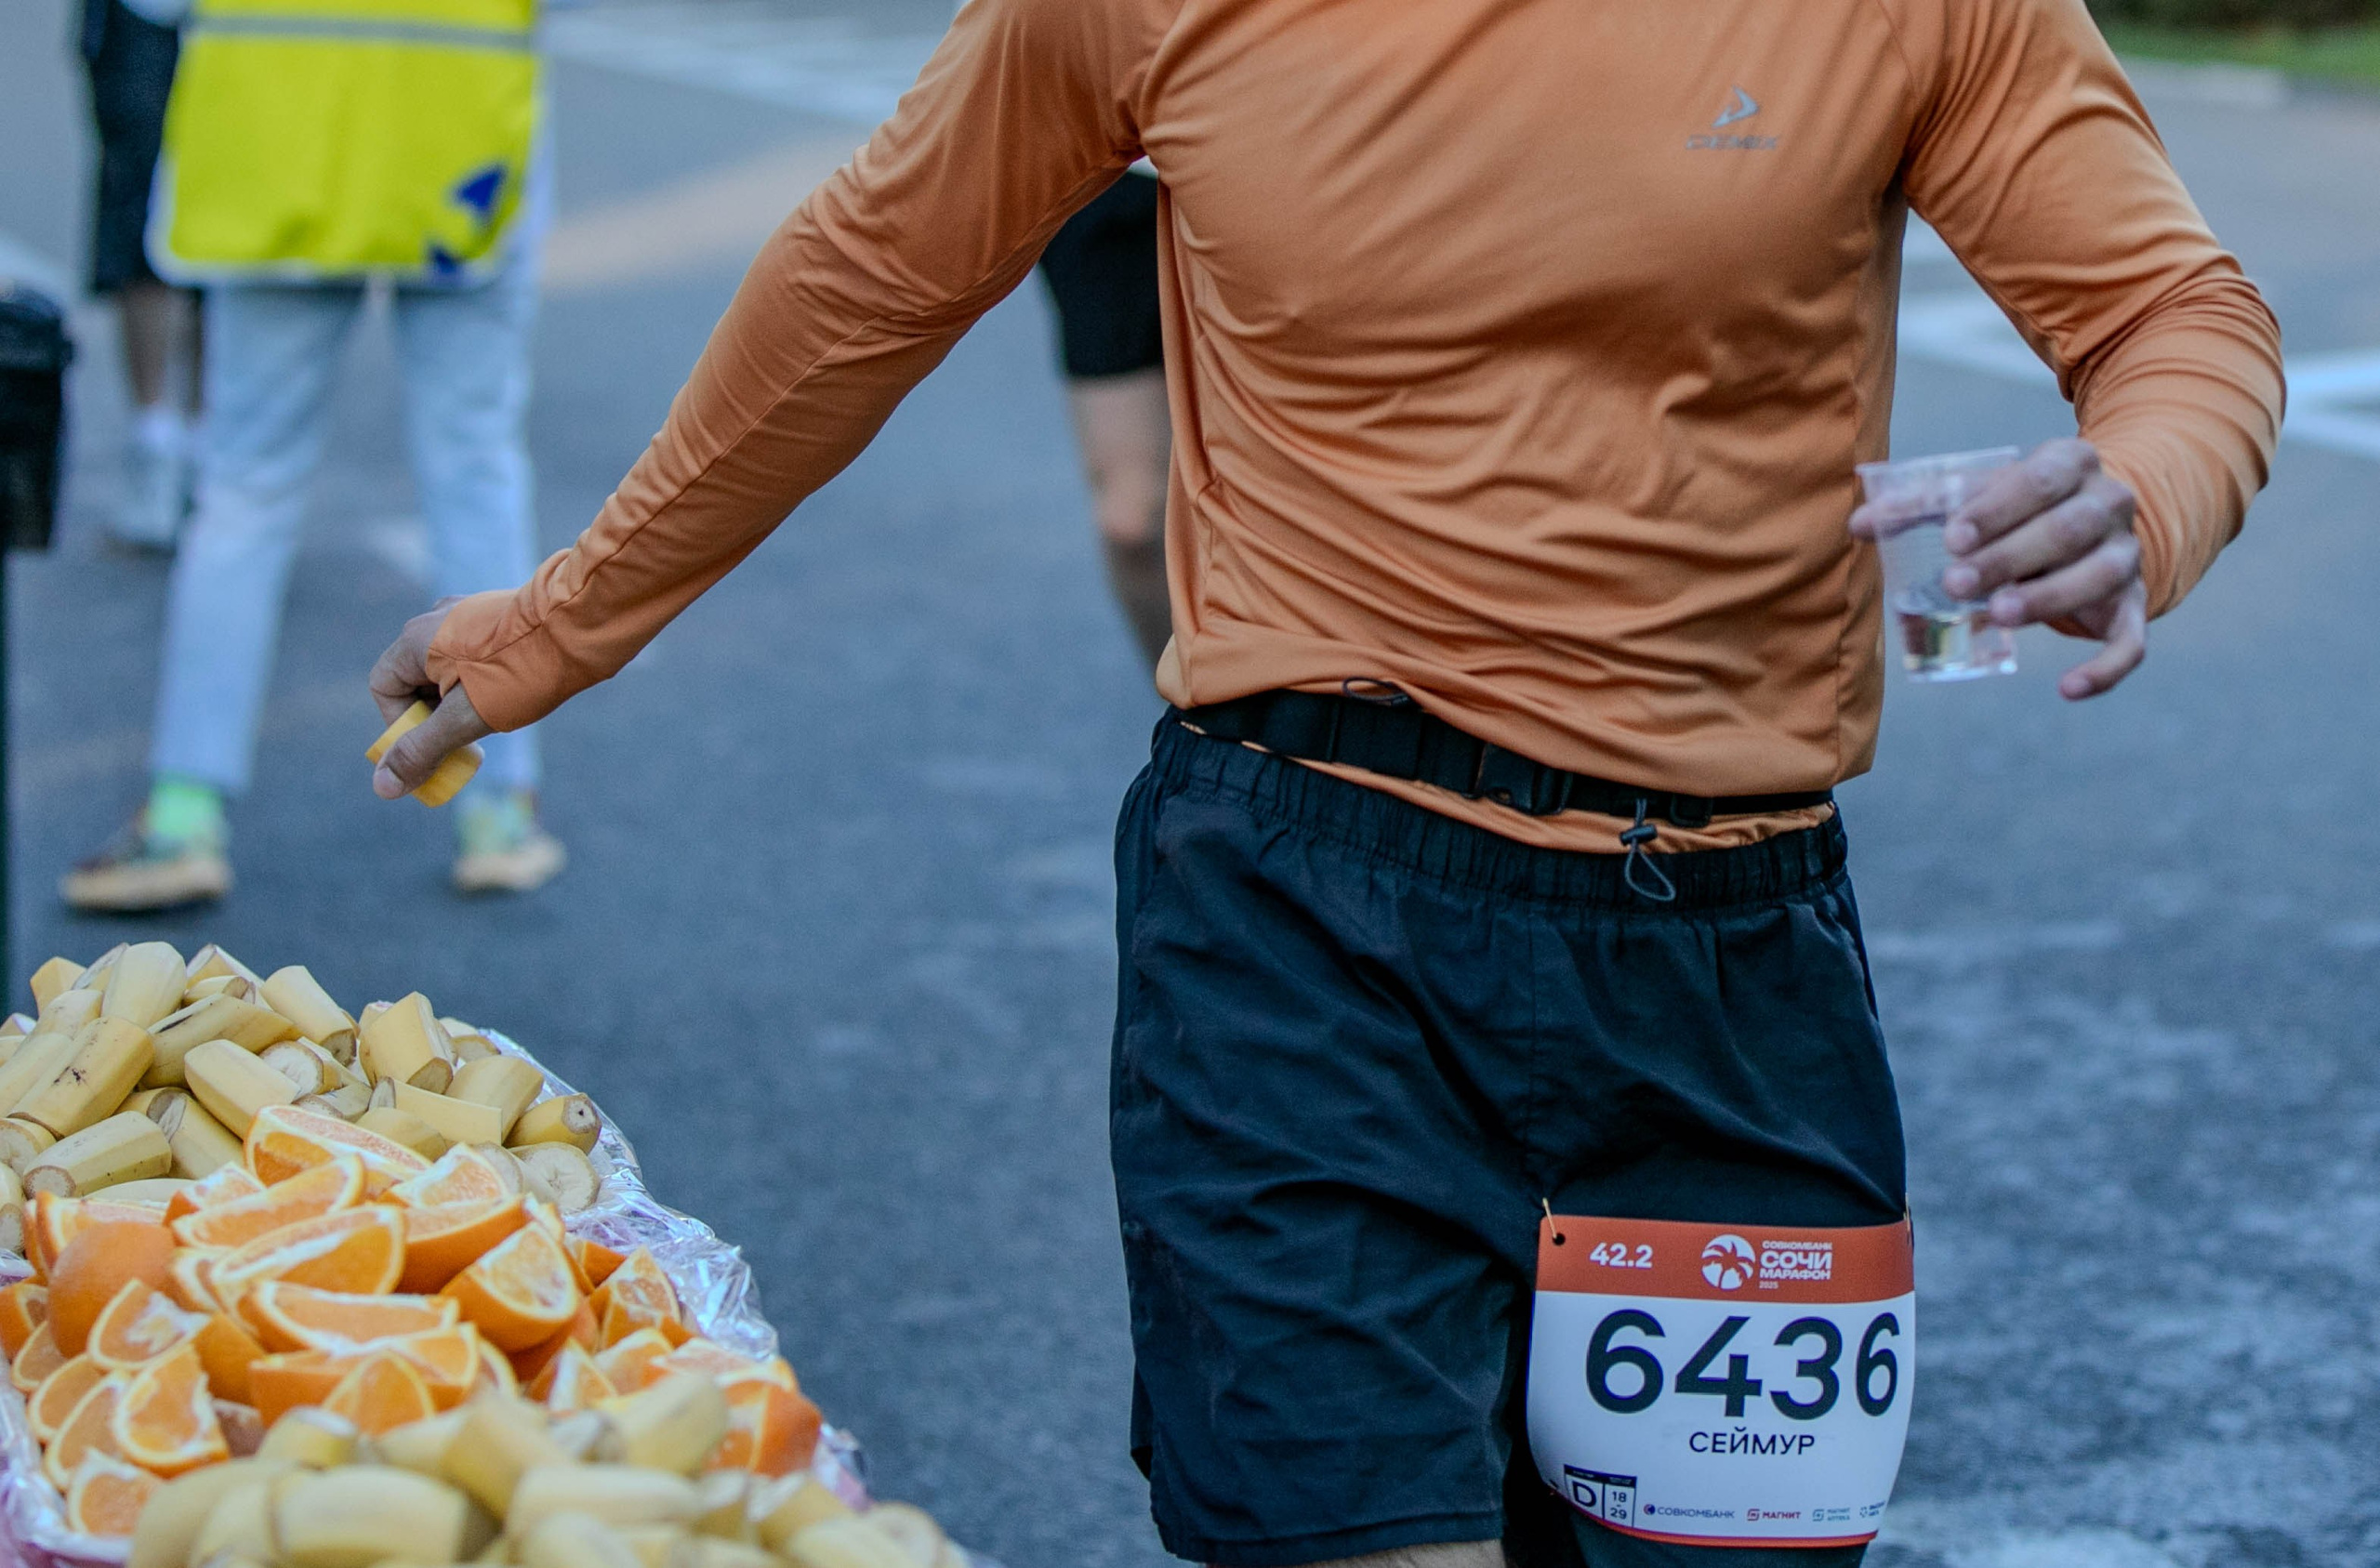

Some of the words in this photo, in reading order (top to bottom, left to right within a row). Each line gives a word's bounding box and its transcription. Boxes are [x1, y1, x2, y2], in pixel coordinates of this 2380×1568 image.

[1590, 1242, 1653, 1269] 42.2
[1760, 1250, 1832, 1270] СОЧИ
[1759, 1268, 1831, 1281] МАРАФОН
[1586, 1309, 1900, 1421] 6436
[1689, 1426, 1816, 1456] СЕЙМУР
[1572, 1481, 1596, 1507] D
[1611, 1491, 1627, 1503] 18
[1610, 1508, 1627, 1520] 29
[1657, 1507, 1735, 1519] СОВКОМБАНК
[1763, 1511, 1802, 1520] МАГНИТ
